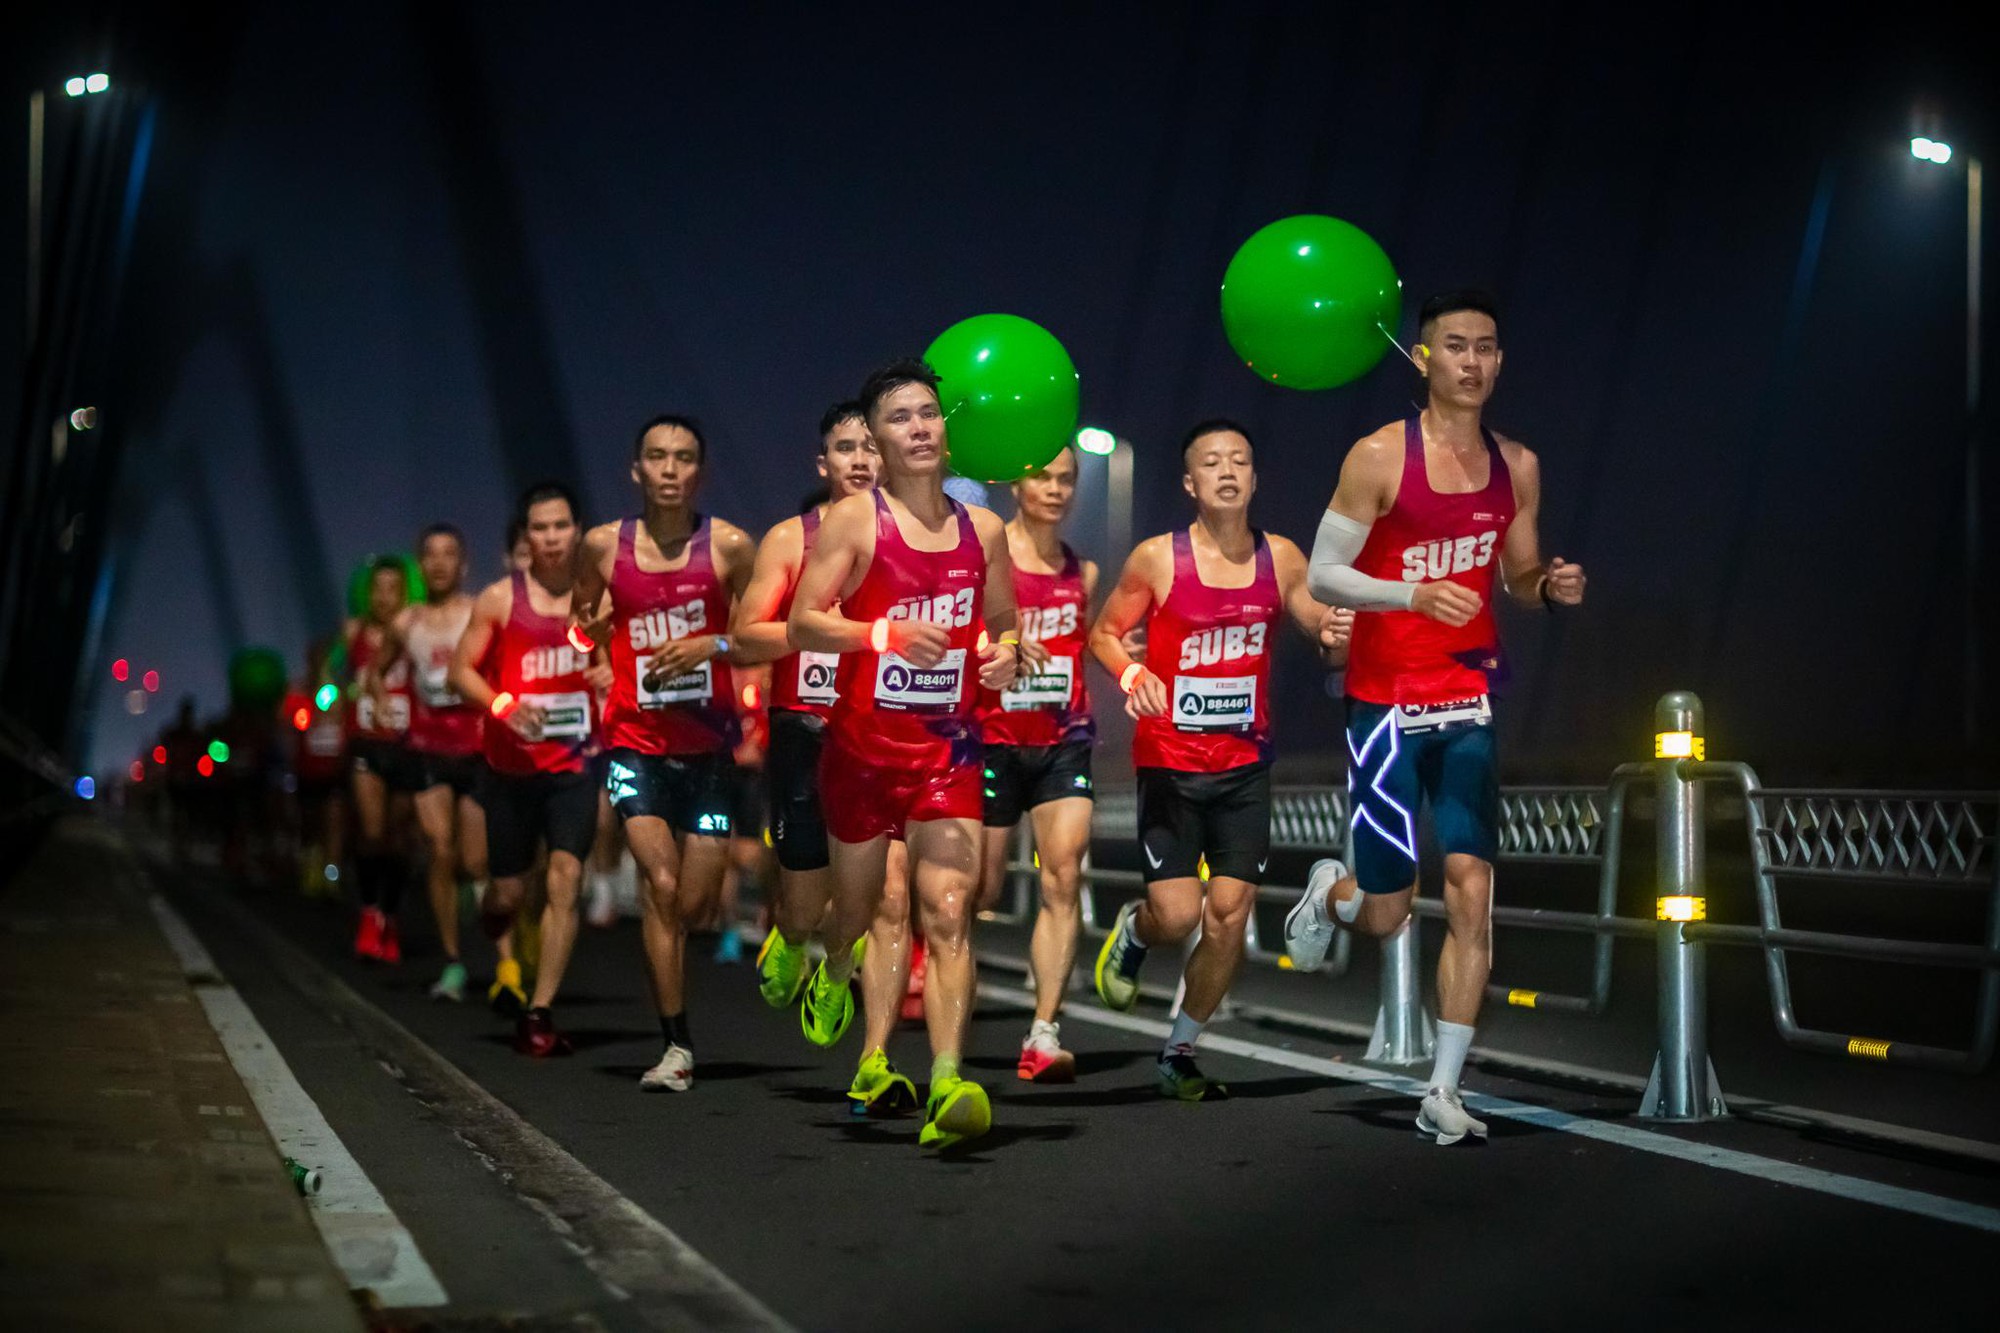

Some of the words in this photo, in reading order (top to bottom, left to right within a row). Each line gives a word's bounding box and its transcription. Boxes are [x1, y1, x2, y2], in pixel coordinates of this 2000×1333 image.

[1402, 531, 1497, 582] SUB3
[629, 599, 707, 651] SUB3
[1021, 603, 1078, 640] UB3
[1179, 622, 1267, 671] SUB3
[807, 668, 823, 684] A
[886, 670, 903, 687] A
[915, 674, 955, 686] 884011
[1182, 696, 1199, 713] A
[1207, 698, 1249, 710] 884461
